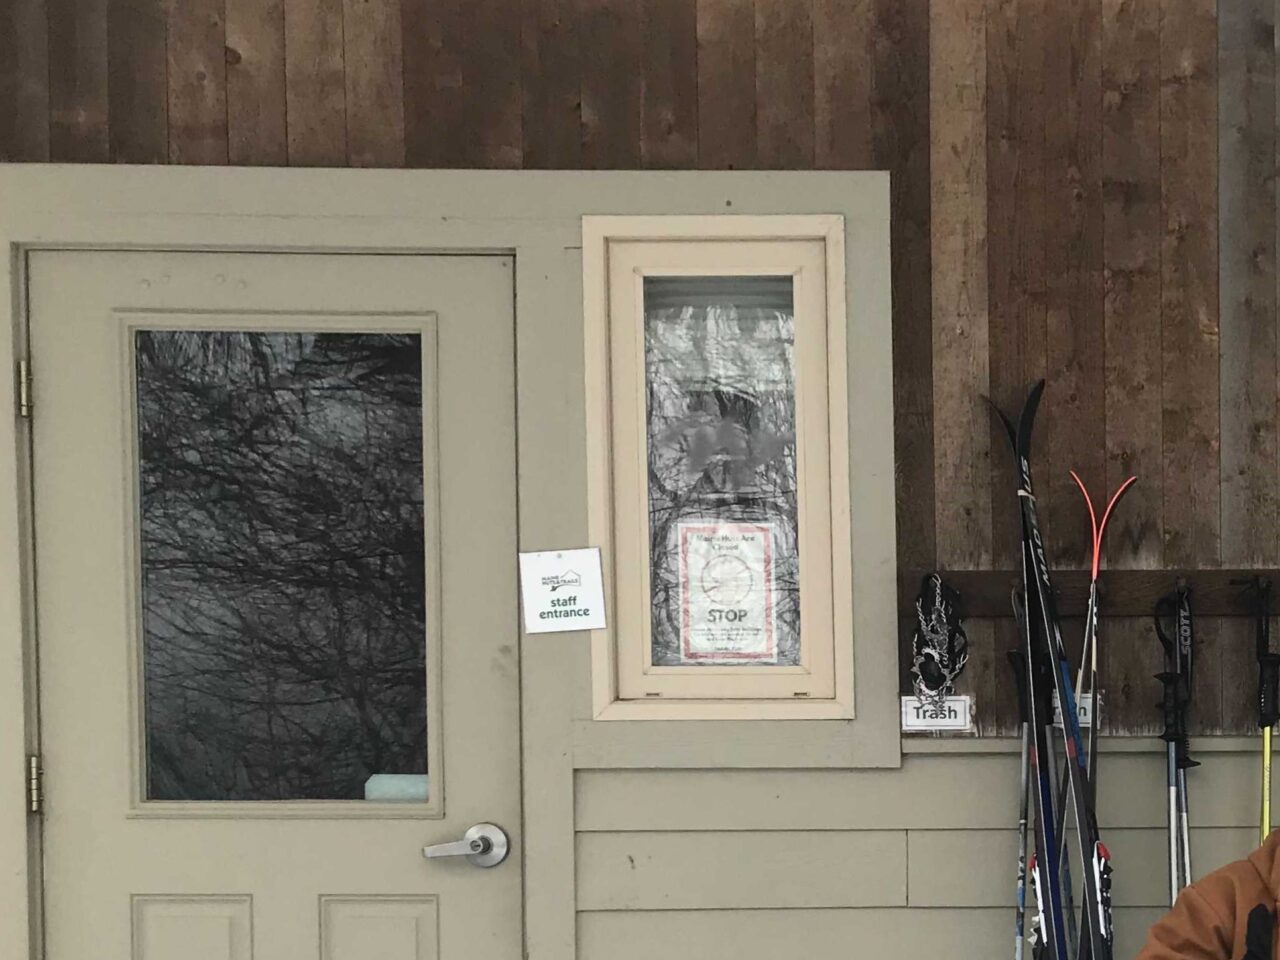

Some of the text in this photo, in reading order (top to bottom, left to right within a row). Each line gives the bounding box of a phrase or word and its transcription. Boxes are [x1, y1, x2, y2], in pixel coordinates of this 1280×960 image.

[550, 595, 577, 607] staff
[539, 608, 590, 619] entrance
[707, 609, 748, 623] STOP
[1180, 608, 1191, 656] SCOTT
[913, 706, 957, 719] Trash
